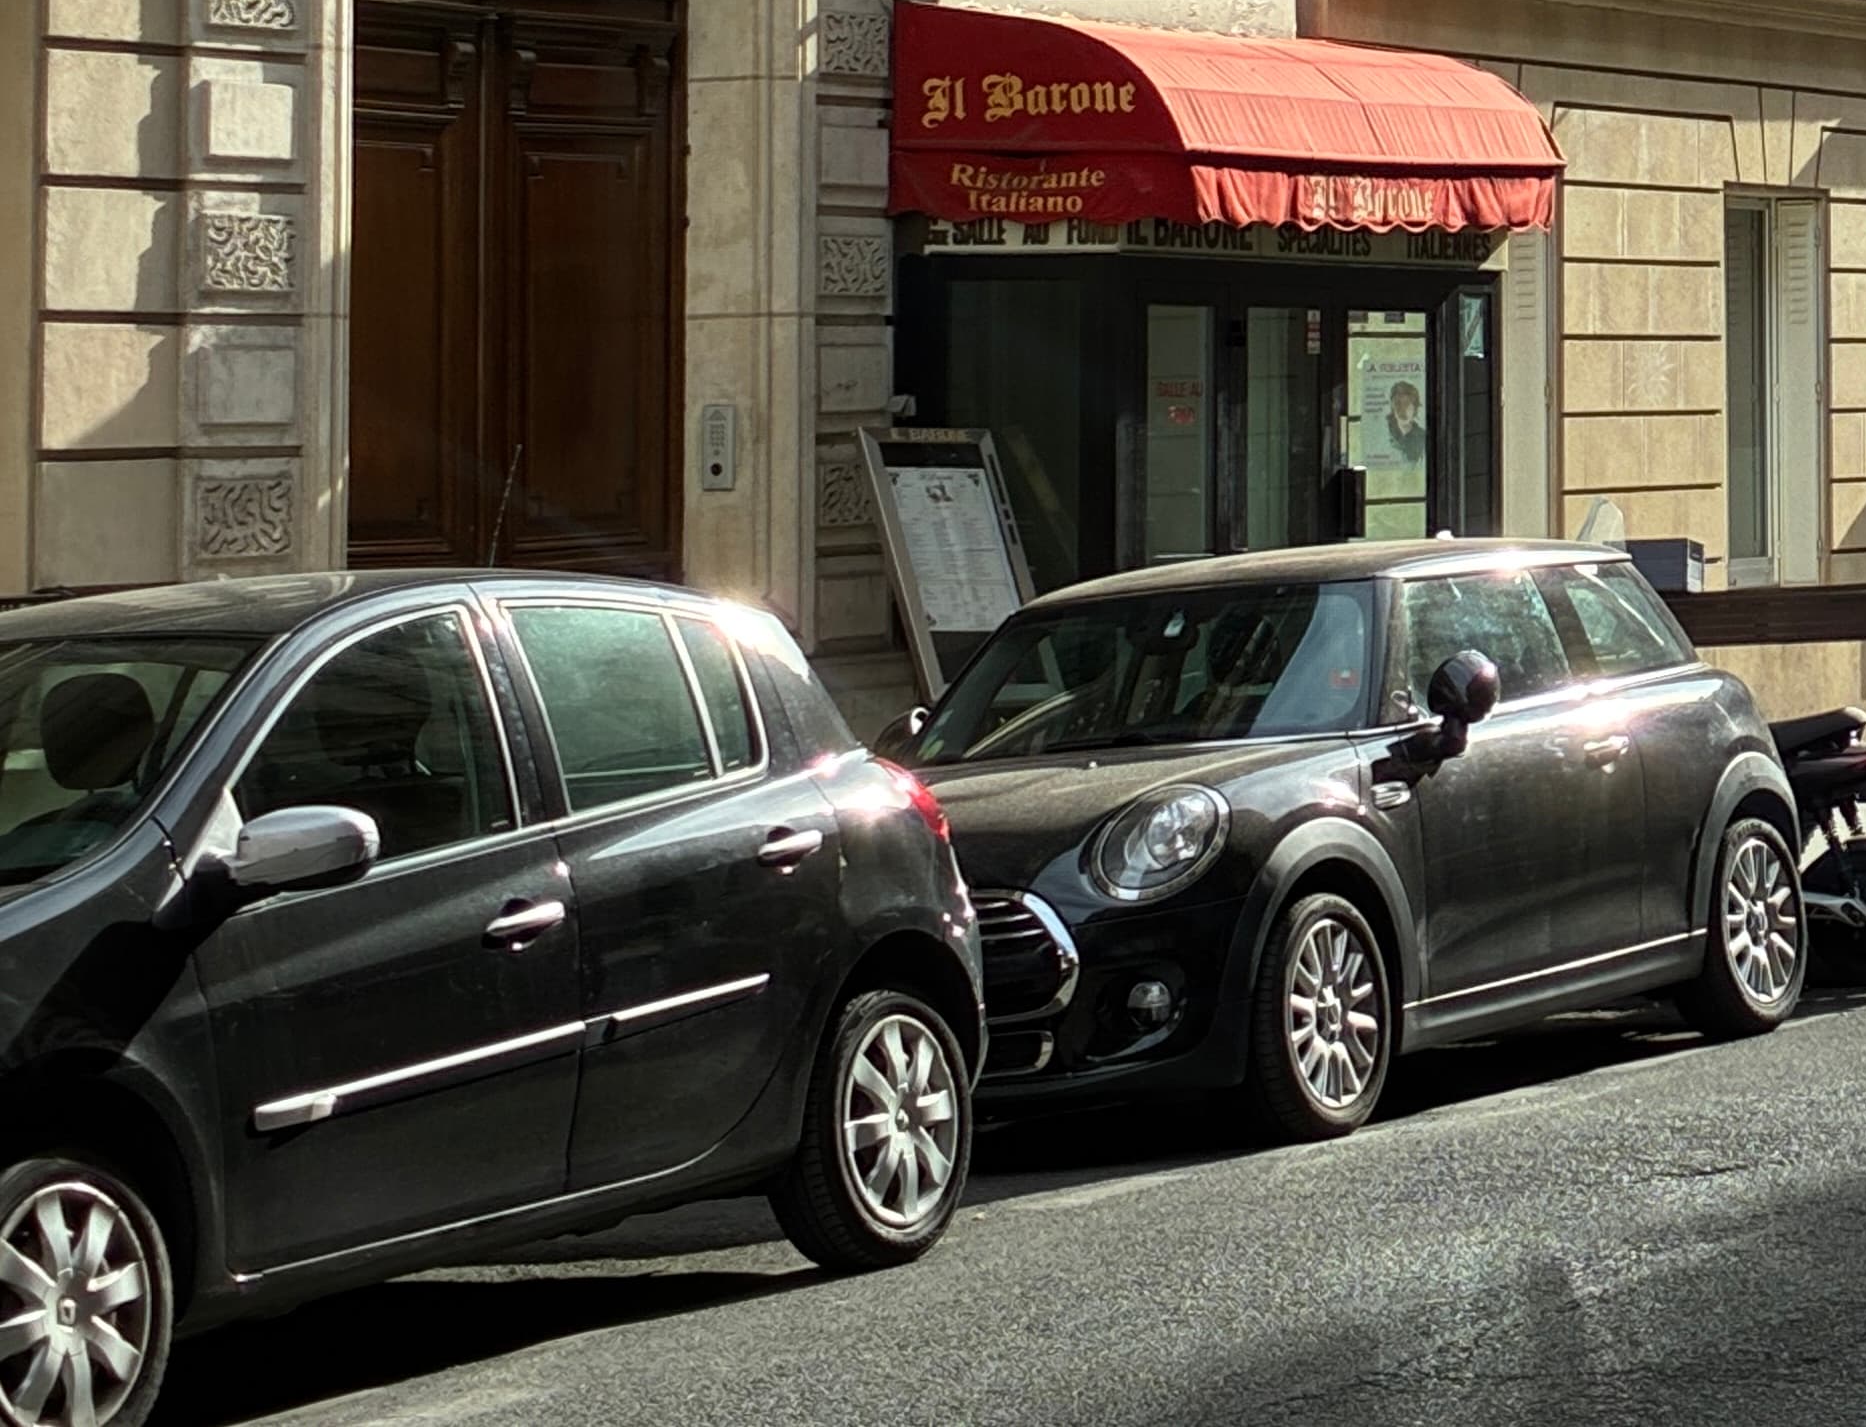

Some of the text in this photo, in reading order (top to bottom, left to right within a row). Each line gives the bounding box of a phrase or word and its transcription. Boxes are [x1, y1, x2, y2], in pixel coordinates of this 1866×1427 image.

[921, 72, 1136, 129] Il Barone
[950, 164, 1106, 190] Ristorante
[968, 190, 1083, 213] Italiano
